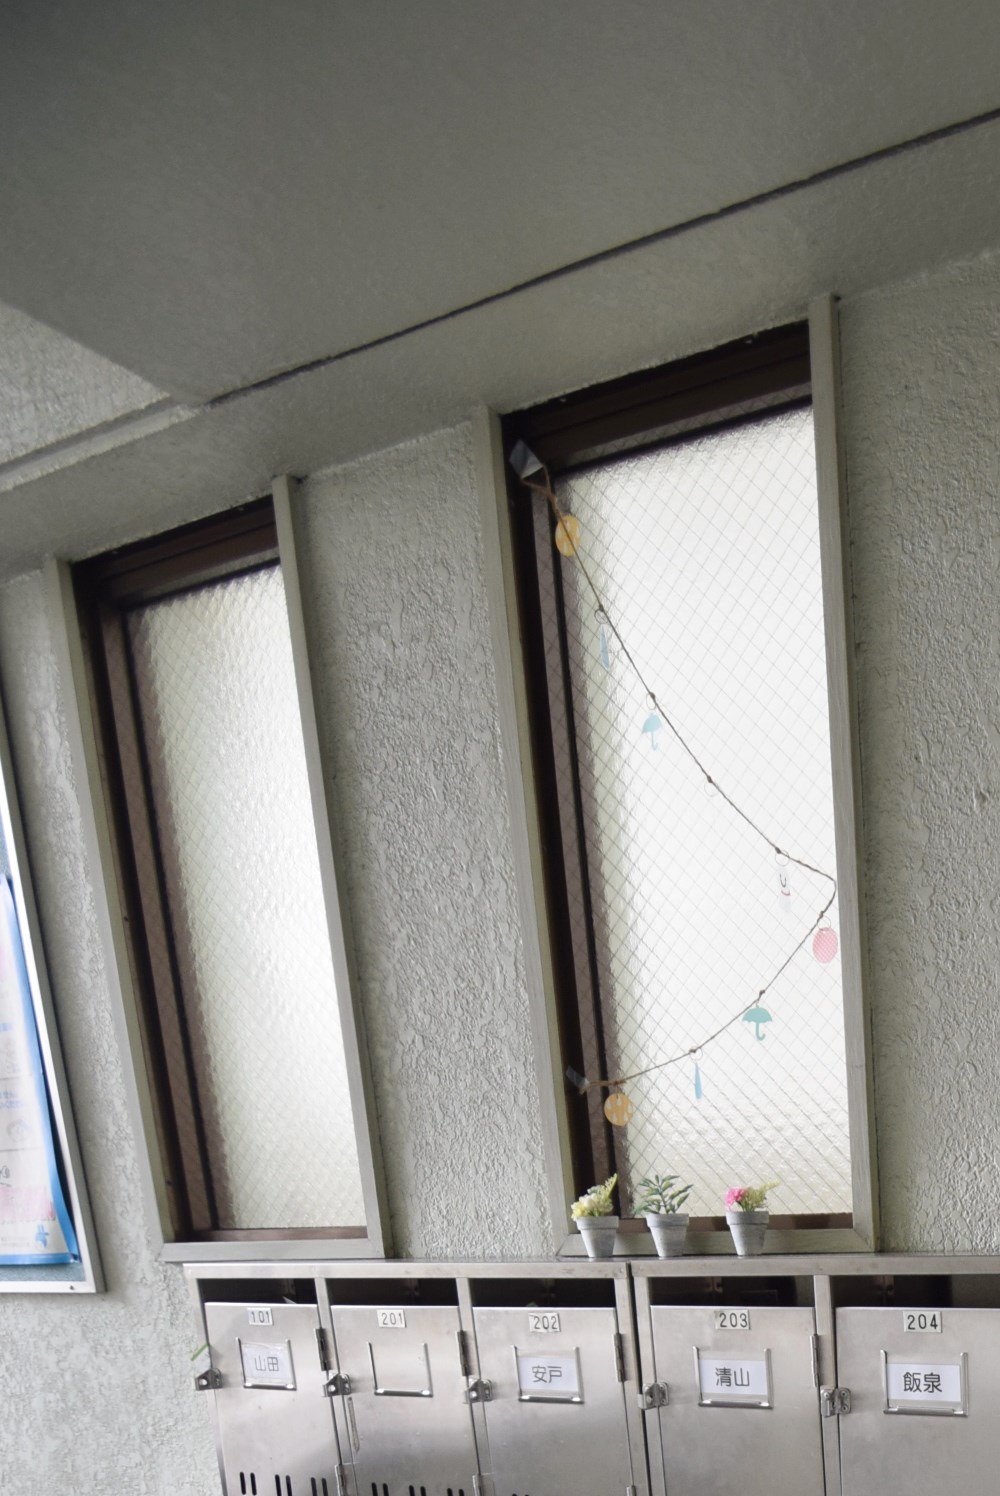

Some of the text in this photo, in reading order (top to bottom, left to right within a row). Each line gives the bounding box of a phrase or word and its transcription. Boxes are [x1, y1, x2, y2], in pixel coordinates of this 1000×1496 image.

[251, 1310, 270, 1324] 101
[381, 1312, 403, 1326] 201
[533, 1315, 558, 1330] 202
[719, 1312, 748, 1328] 203
[907, 1313, 938, 1330] 204
[254, 1355, 279, 1372] 山田
[531, 1365, 563, 1383] 安戸
[715, 1367, 750, 1387] 清山
[903, 1371, 943, 1393] 飯泉
